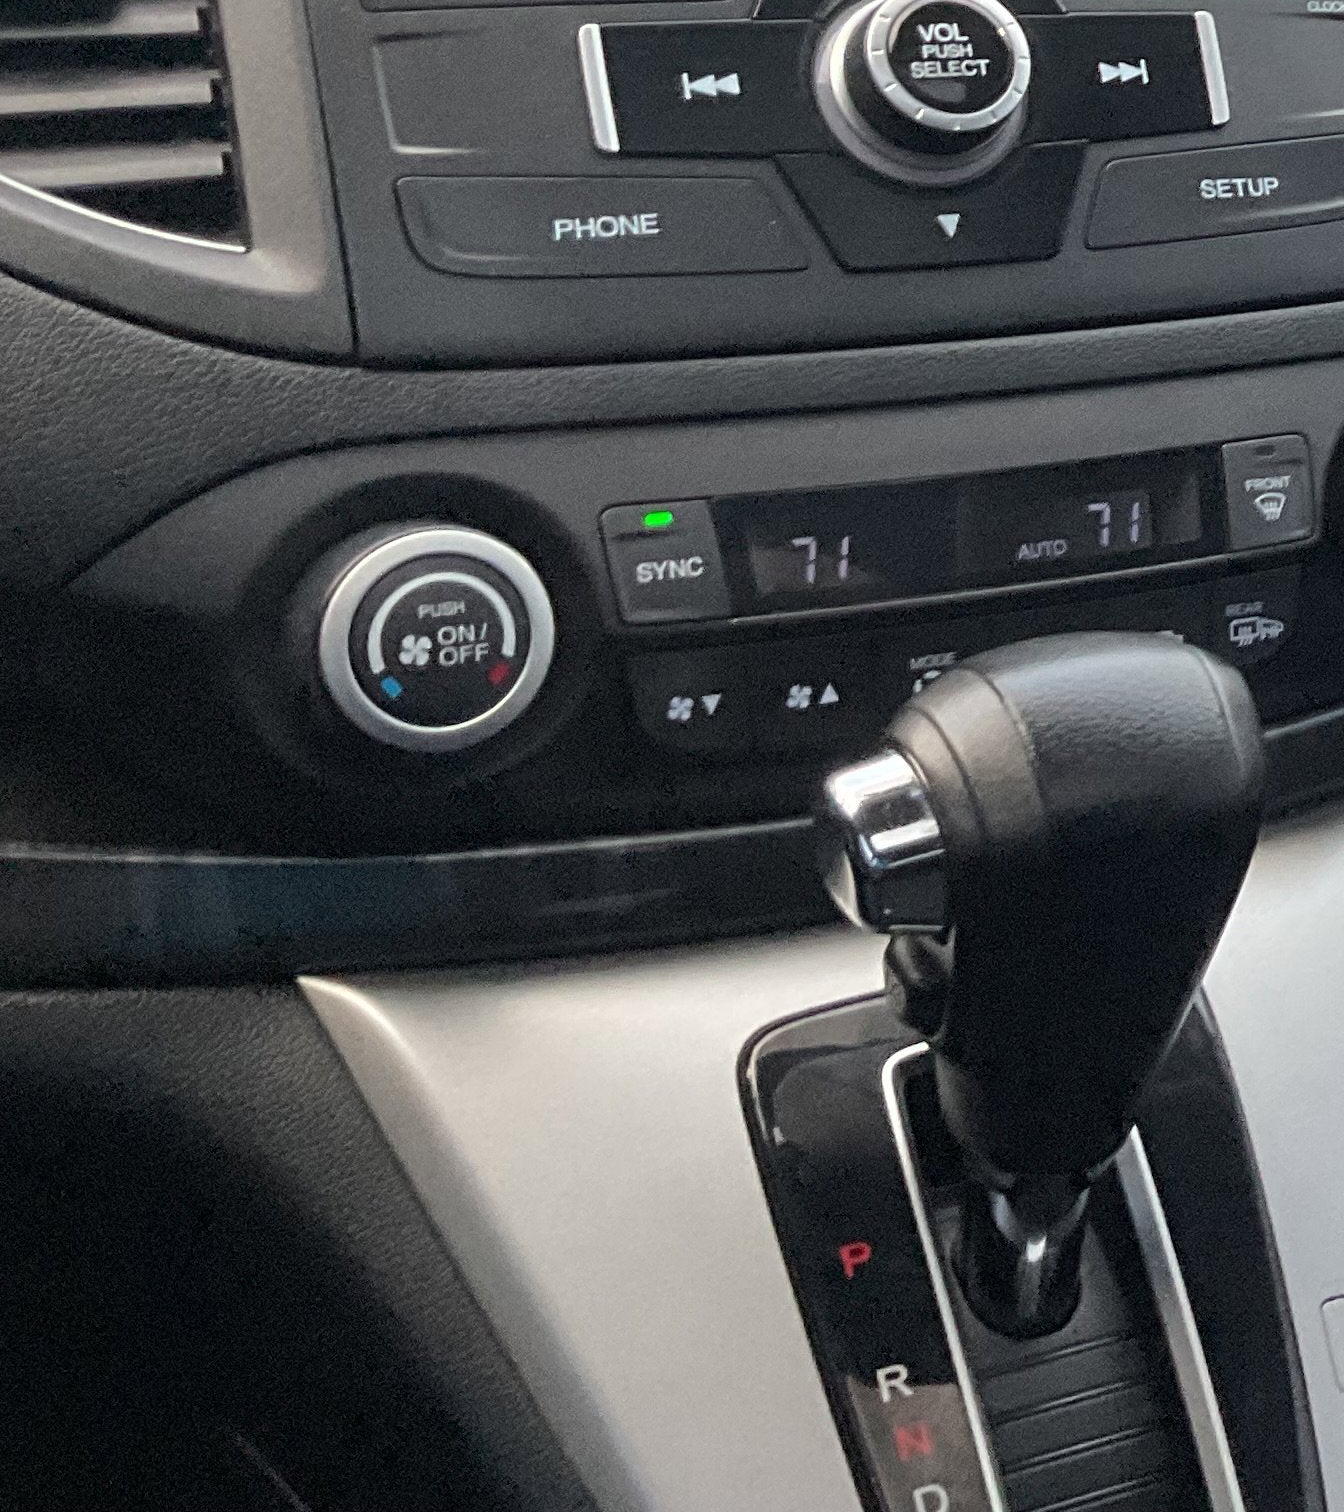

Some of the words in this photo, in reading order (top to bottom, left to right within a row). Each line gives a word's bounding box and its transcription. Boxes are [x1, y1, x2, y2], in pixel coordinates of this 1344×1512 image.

[918, 23, 970, 43] VOL
[921, 44, 973, 60] PUSH
[910, 58, 990, 80] SELECT
[1199, 176, 1279, 200] SETUP
[552, 213, 660, 242] PHONE
[1245, 474, 1292, 493] FRONT
[1087, 501, 1142, 548] 71
[791, 535, 852, 585] 71
[1016, 538, 1069, 561] AUTO
[635, 556, 705, 584] SYNC
[417, 599, 465, 619] PUSH
[437, 643, 489, 668] OFF
[839, 1240, 872, 1280] P
[876, 1363, 914, 1403] R
[893, 1420, 934, 1463] N
[912, 1482, 950, 1512] D
